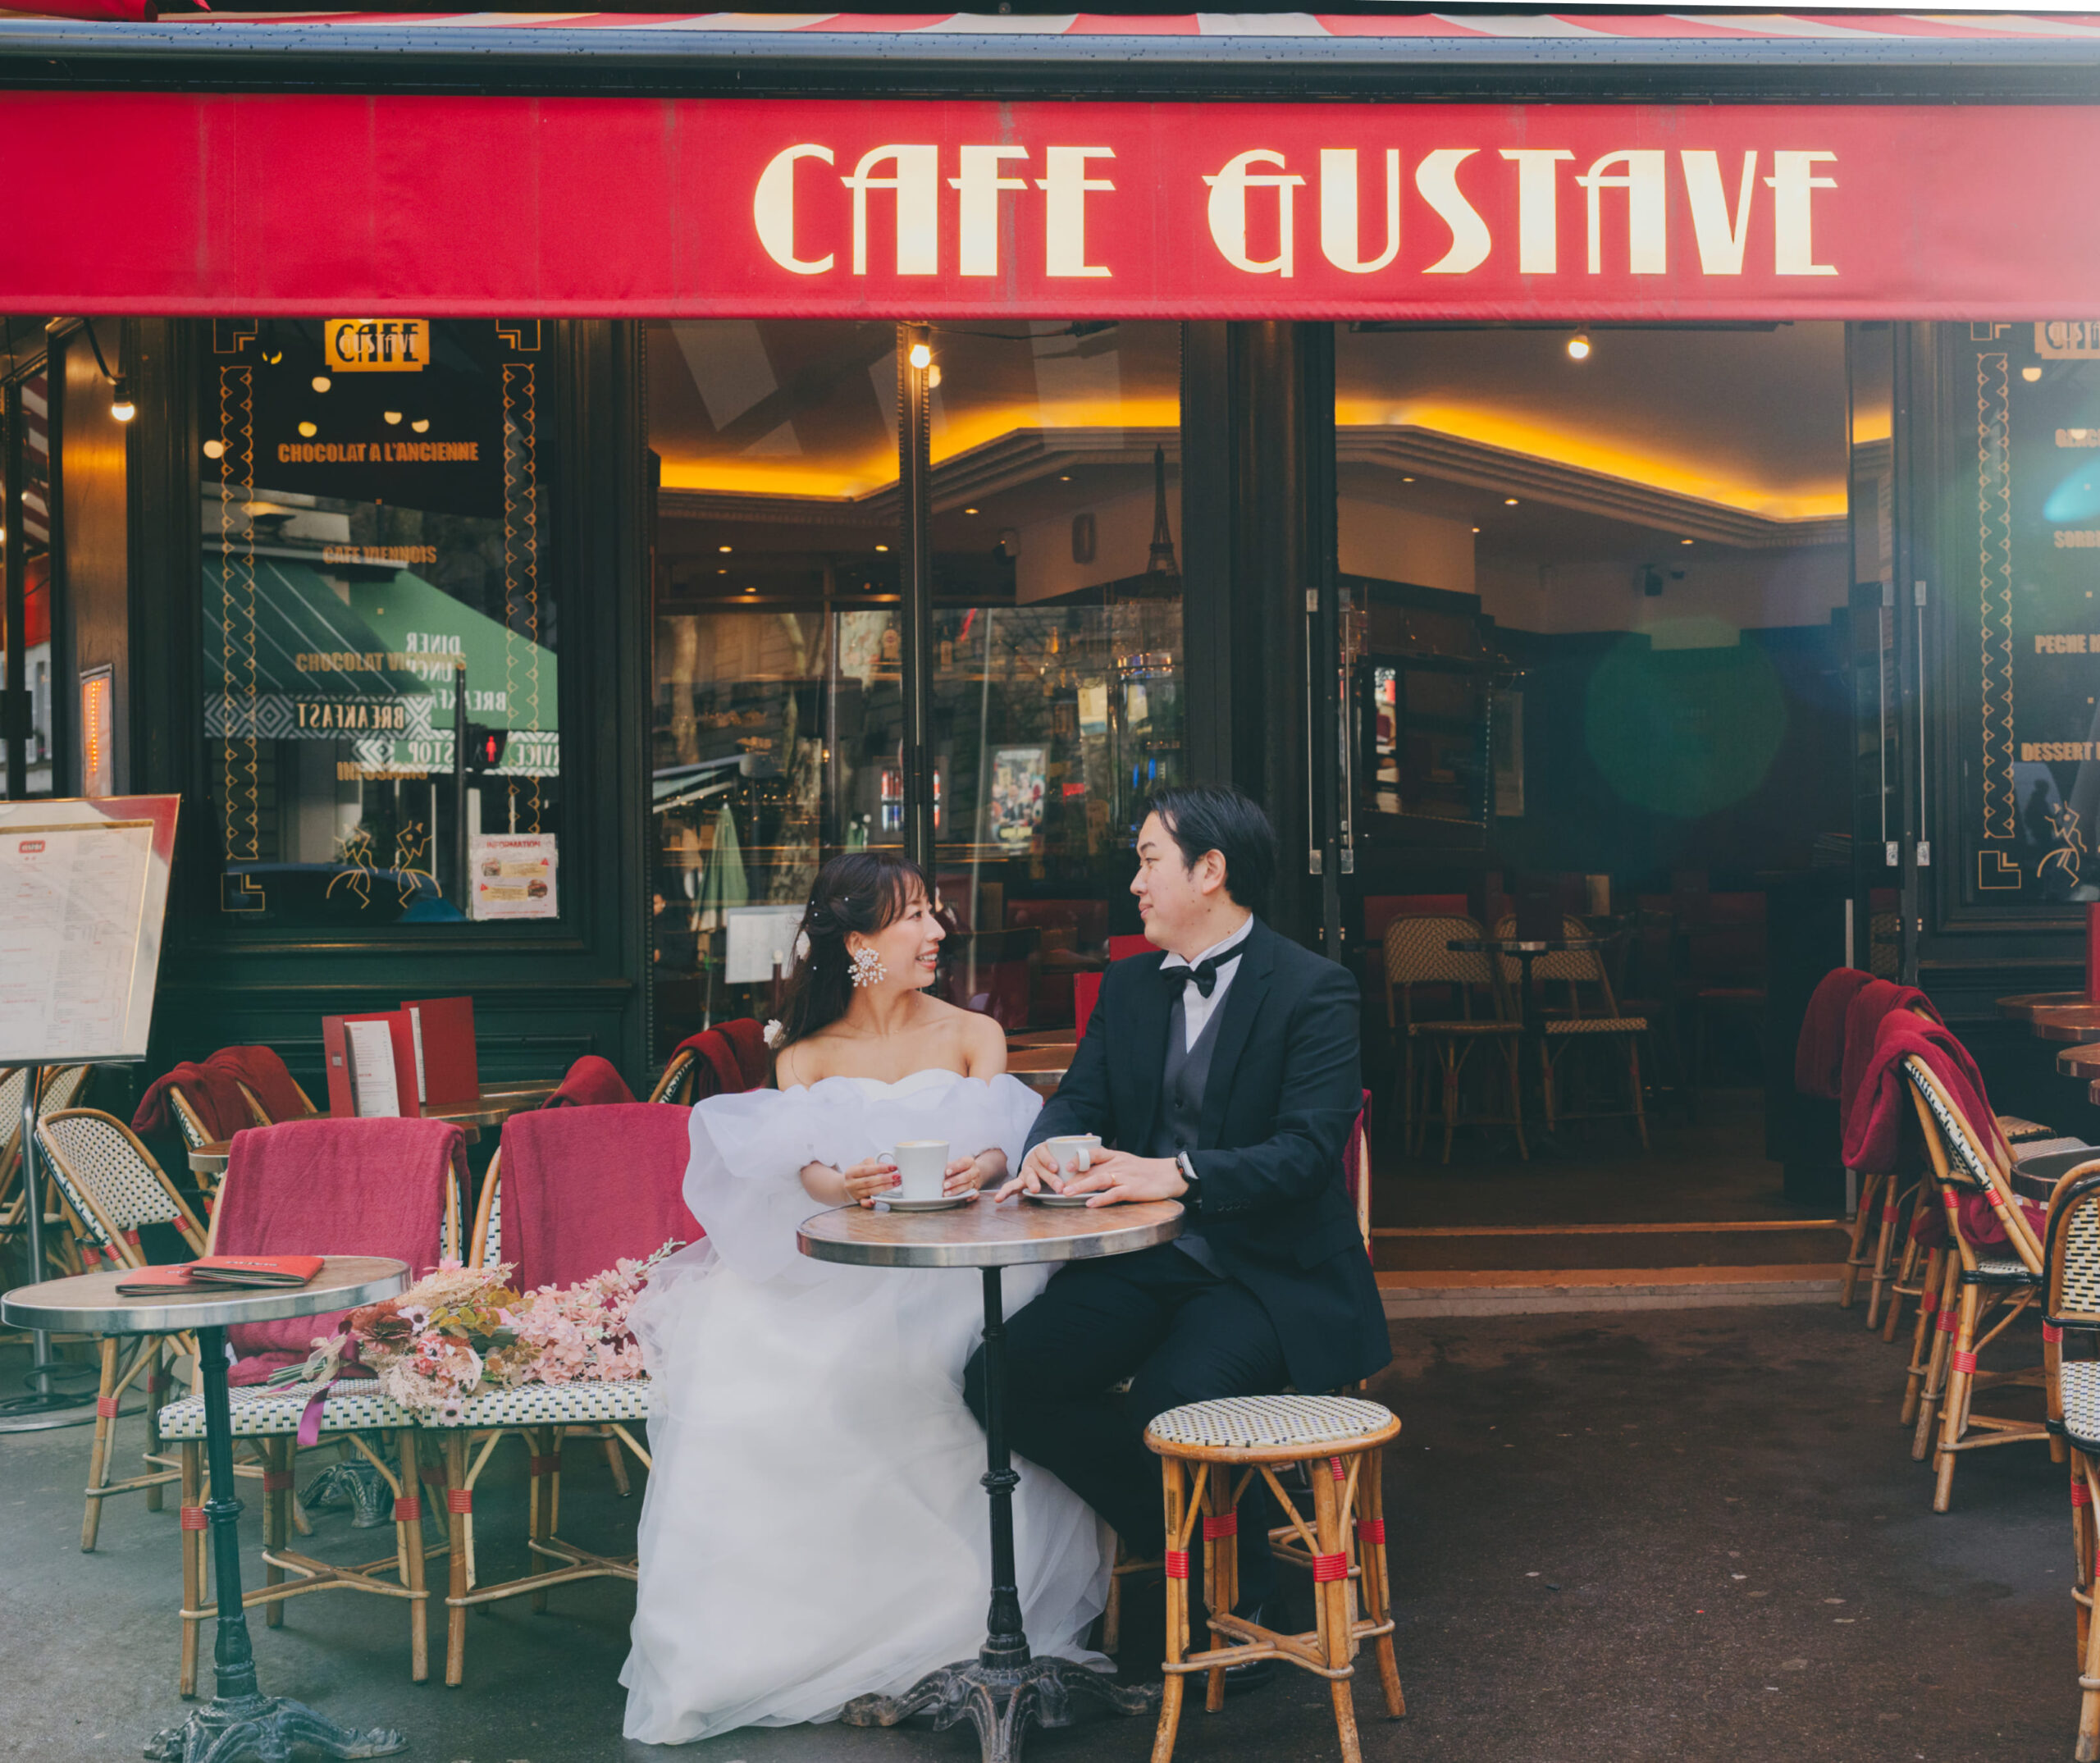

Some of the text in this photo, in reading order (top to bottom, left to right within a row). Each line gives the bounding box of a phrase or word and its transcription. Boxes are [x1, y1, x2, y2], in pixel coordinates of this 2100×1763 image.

[754, 144, 1839, 278] CAFE GUSTAVE
[336, 323, 419, 363] CAFE
[278, 441, 479, 463] CHOCOLAT A L'ANCIENNE
[322, 545, 437, 564] CAFE VIENNOIS
[2035, 634, 2086, 653] PECHE
[295, 652, 384, 672] CHOCOLAT
[2021, 742, 2093, 761] DESSERT
